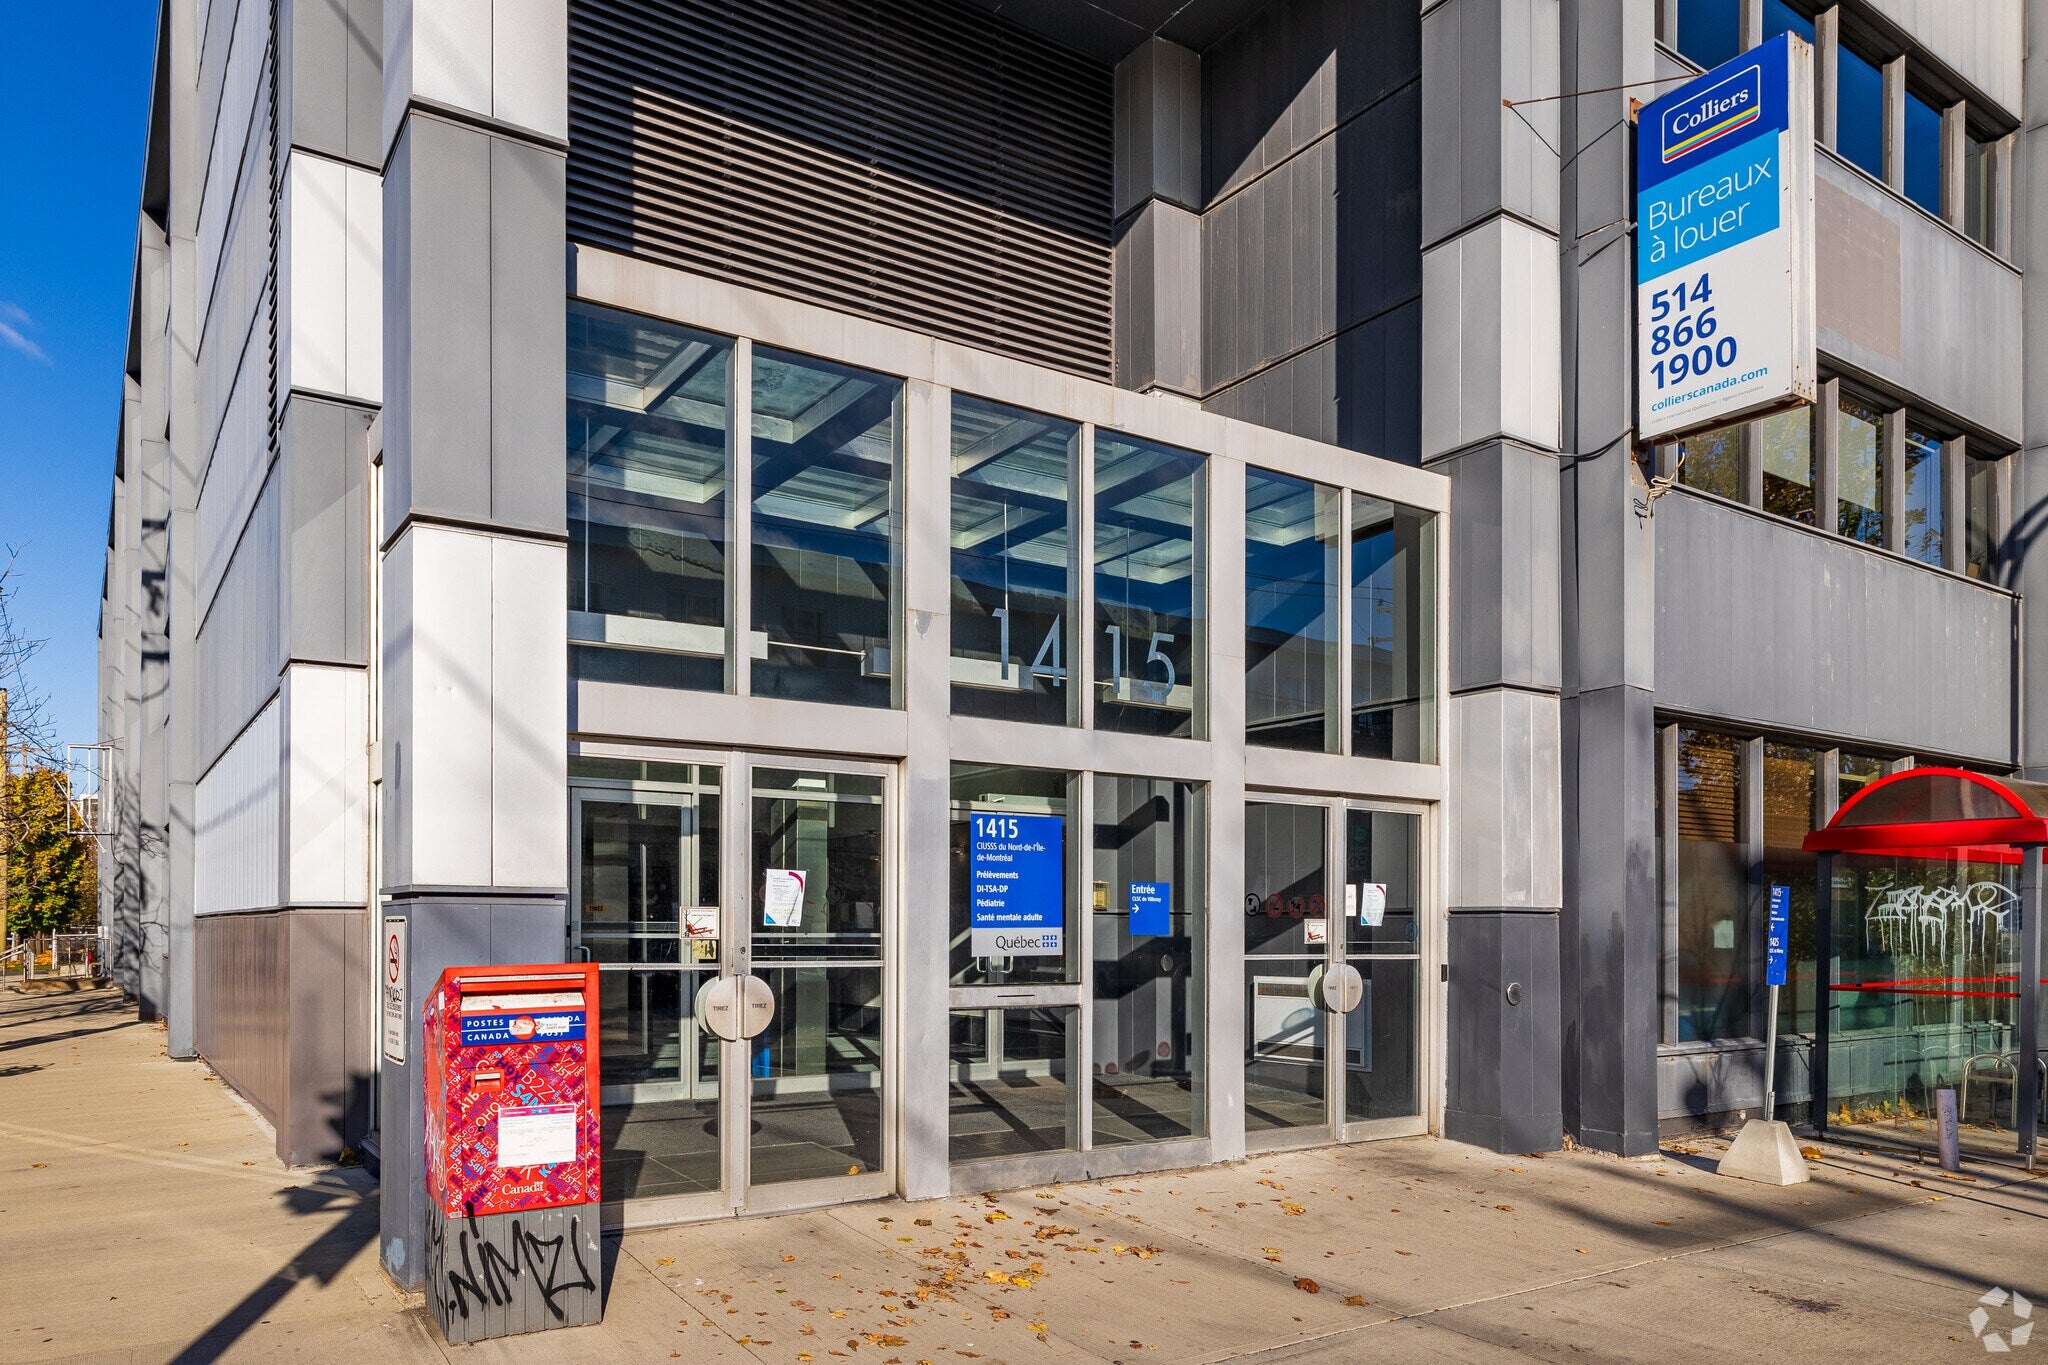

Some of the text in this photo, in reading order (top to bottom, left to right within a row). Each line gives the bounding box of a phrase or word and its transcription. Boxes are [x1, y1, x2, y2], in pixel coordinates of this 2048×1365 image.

[1673, 89, 1749, 134] Colliers
[1649, 158, 1772, 230] Bureaux
[1650, 202, 1750, 262] à louer
[1651, 272, 1712, 322] 514
[1651, 306, 1716, 356] 866
[1651, 337, 1737, 389] 1900
[1651, 367, 1768, 412] collierscanada.com
[976, 818, 1018, 838] 1415
[976, 842, 997, 850] CIUSSS
[977, 853, 1013, 862] de-Montréal
[976, 870, 1019, 879] Prélèvements
[1131, 884, 1155, 894] Entrée
[977, 913, 995, 921] Santé
[996, 935, 1040, 951] Québec
[467, 1018, 504, 1027] POSTES
[467, 1032, 509, 1041] CANADA
[523, 1070, 553, 1101] B2Z
[468, 1159, 485, 1175] S4N
[502, 1182, 543, 1195] Canada
